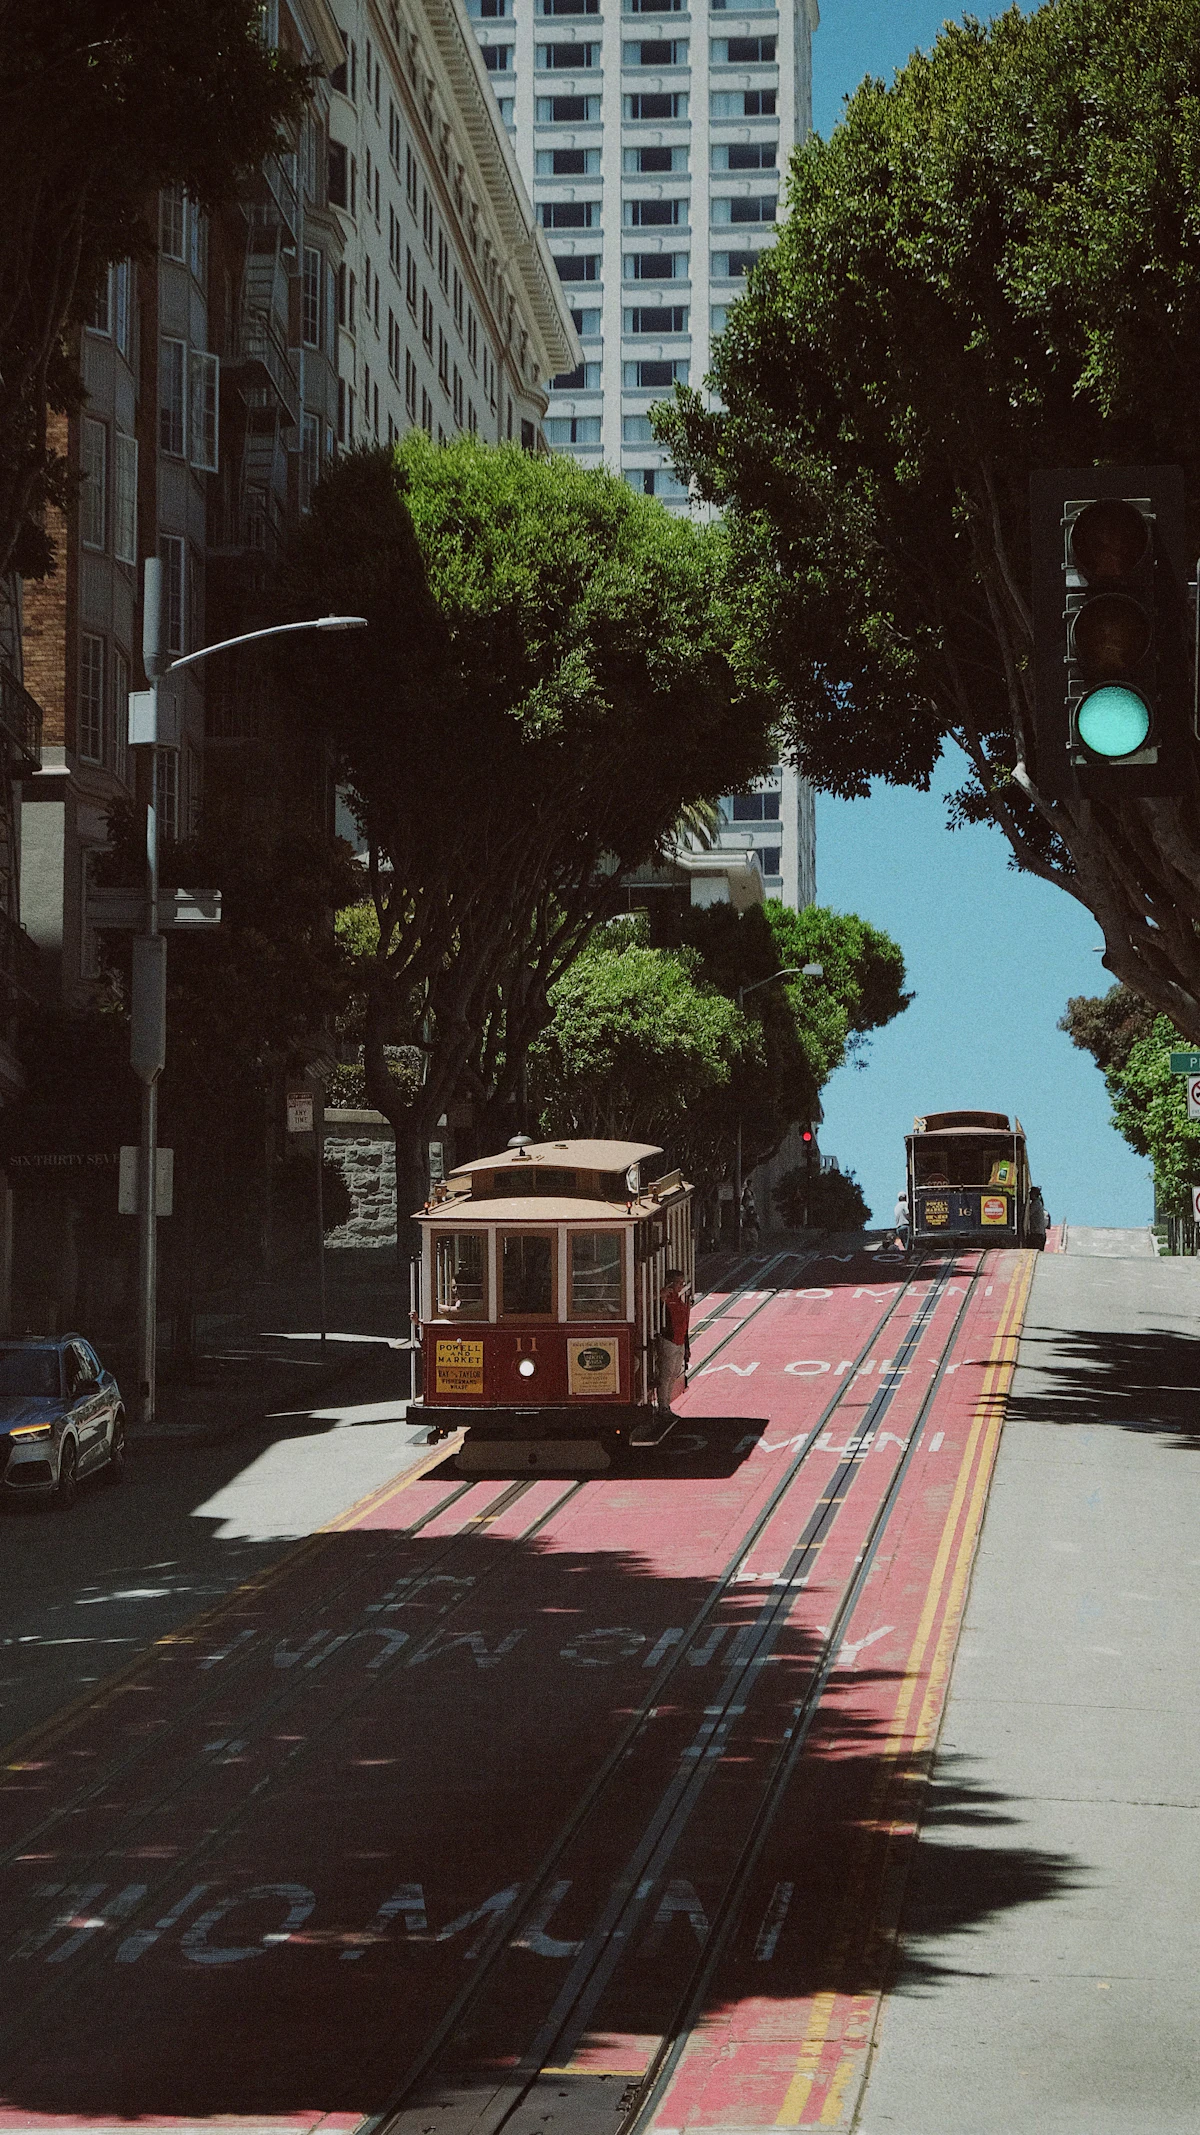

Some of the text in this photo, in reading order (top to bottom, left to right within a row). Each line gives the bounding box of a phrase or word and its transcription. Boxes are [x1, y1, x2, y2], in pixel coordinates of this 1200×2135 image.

[1189, 1057, 1200, 1069] P
[10, 1153, 120, 1166] SIX THIRTY SEVE
[851, 1286, 994, 1299] MUNI
[439, 1344, 481, 1352] POWELL
[515, 1337, 538, 1352] 11
[438, 1356, 481, 1364] MARKET
[459, 1370, 481, 1379] TAYLOR
[784, 1360, 974, 1377] ONLY
[731, 1432, 945, 1454] MUNI
[559, 1625, 896, 1669] ONLY
[338, 1879, 796, 1963] MUNI
